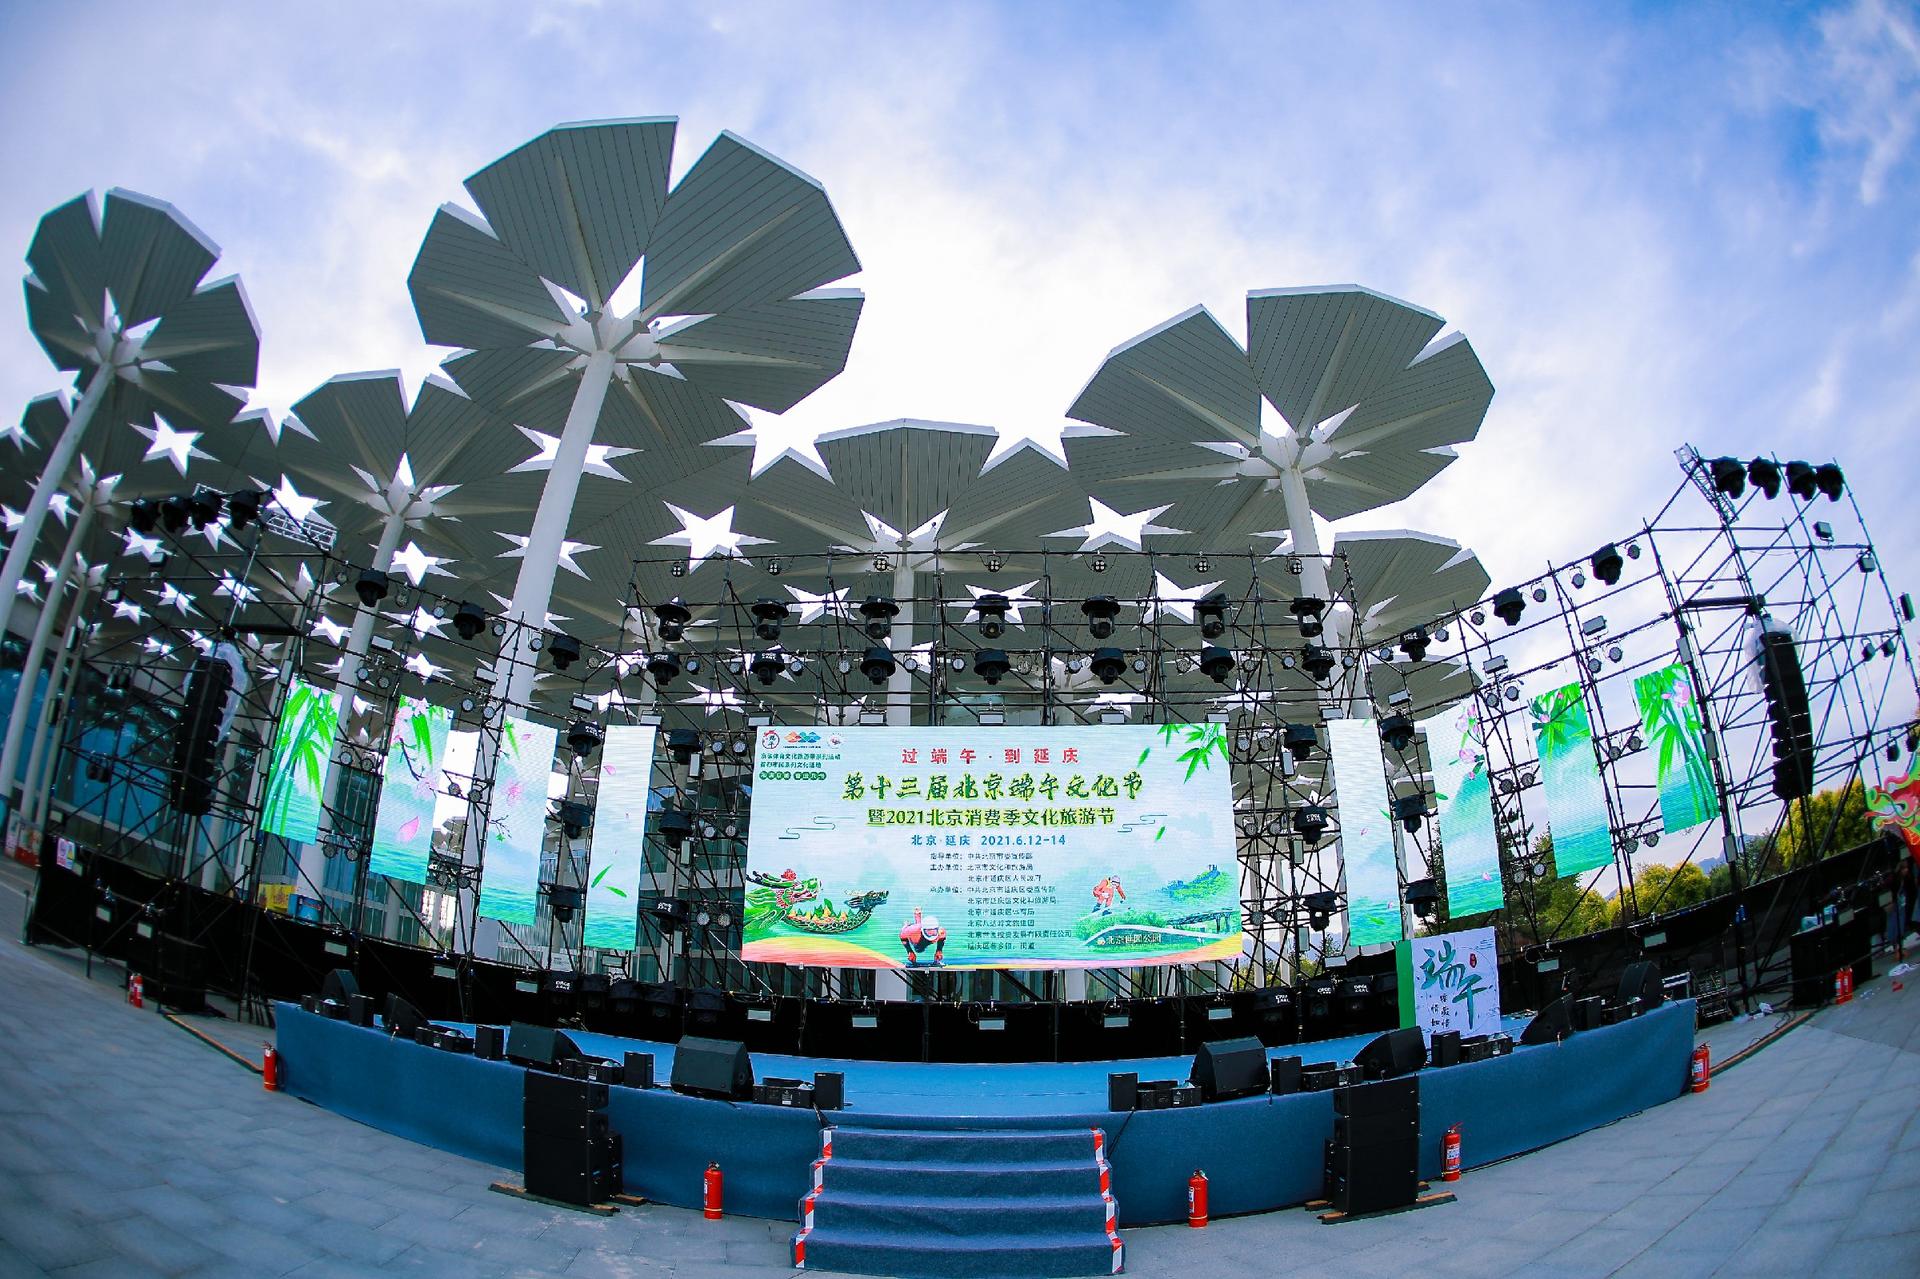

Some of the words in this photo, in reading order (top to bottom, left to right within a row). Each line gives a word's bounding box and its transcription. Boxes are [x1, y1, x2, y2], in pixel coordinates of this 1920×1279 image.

[901, 748, 1081, 764] 过端午·到延庆
[843, 771, 1144, 801] 第十三届北京端午文化节
[867, 807, 1116, 827] 暨2021北京消费季文化旅游节
[981, 834, 1066, 846] 2021.6.12-14
[1420, 940, 1483, 1030] 端午
